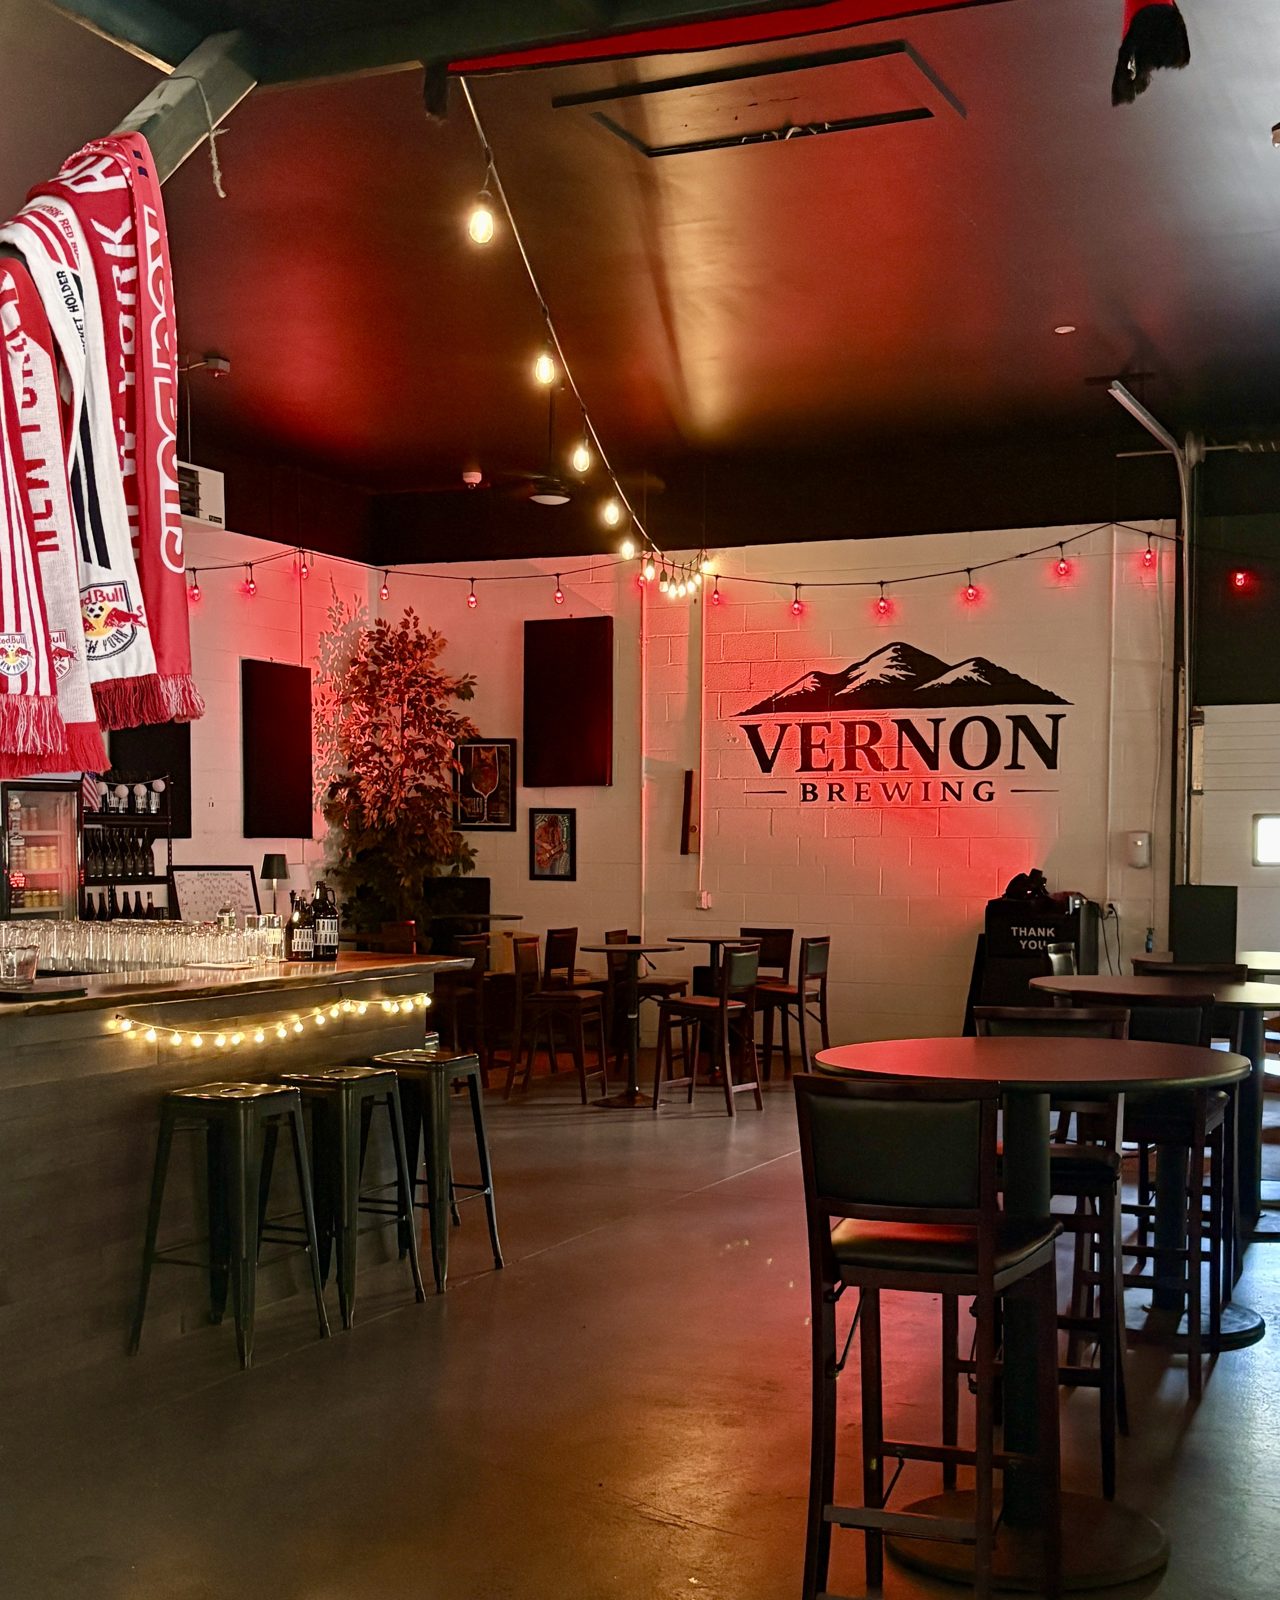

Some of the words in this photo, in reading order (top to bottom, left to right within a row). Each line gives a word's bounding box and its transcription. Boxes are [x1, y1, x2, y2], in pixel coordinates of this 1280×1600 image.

[59, 218, 74, 239] RED
[56, 270, 79, 312] HOLDER
[94, 587, 124, 602] Bull
[103, 629, 129, 651] YORK
[739, 713, 1067, 773] VERNON
[800, 780, 995, 802] BREWING
[1010, 926, 1056, 937] THANK
[1019, 939, 1047, 950] YOU
